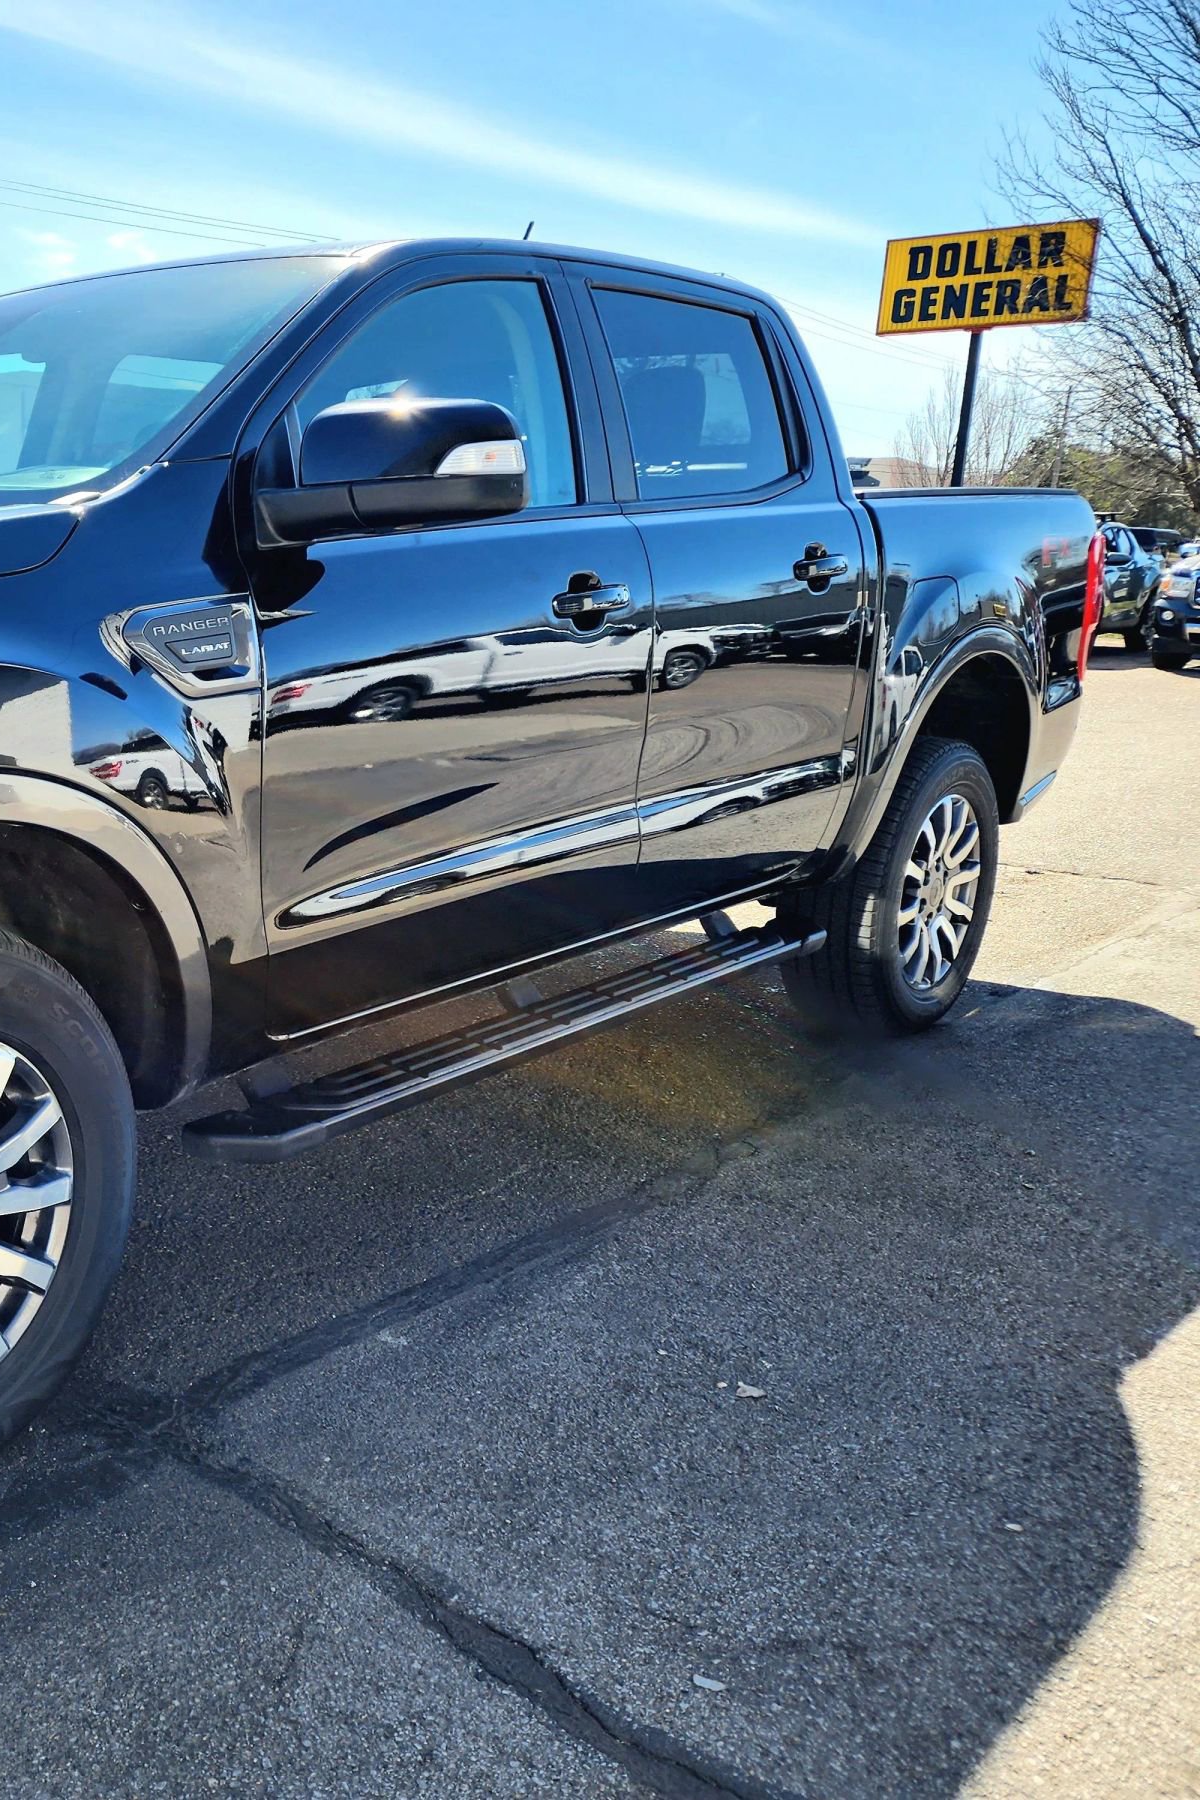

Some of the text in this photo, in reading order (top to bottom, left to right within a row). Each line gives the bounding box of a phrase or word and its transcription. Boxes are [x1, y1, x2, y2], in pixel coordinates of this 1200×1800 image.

[907, 231, 1066, 281] DOLLAR
[891, 274, 1072, 323] GENERAL
[152, 616, 230, 637] RANGER
[181, 641, 231, 656] LARIAT
